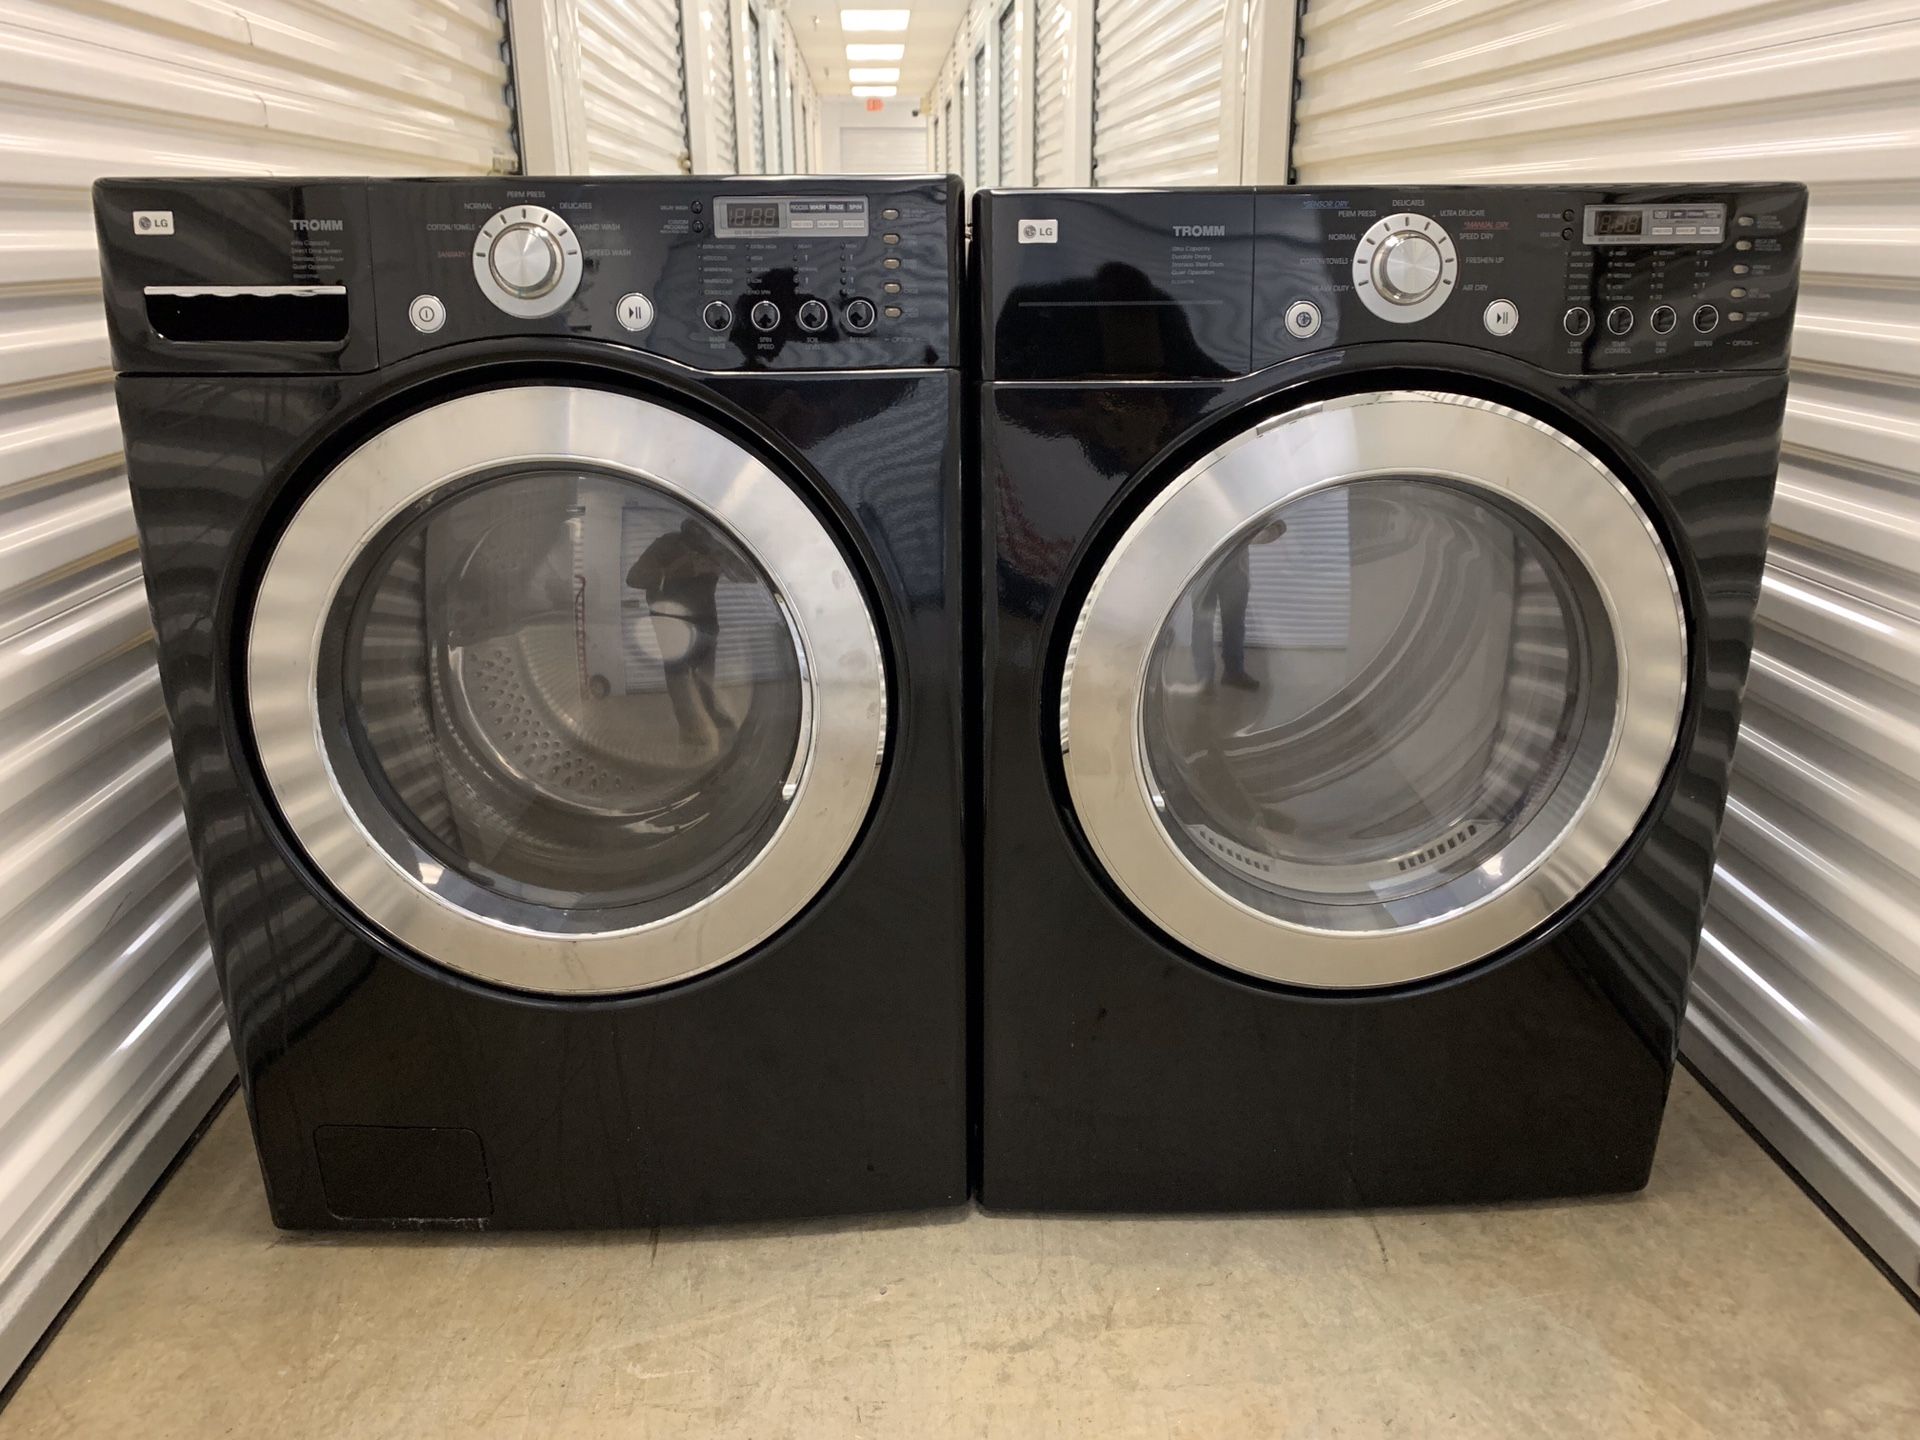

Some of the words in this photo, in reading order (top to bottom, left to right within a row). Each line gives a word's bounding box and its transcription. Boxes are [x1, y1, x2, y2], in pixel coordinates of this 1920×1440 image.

[507, 191, 526, 199] PERM
[559, 202, 593, 210] DELICATES
[809, 203, 827, 211] WASH
[829, 203, 845, 211] RINSE
[1392, 199, 1425, 207] DELICATES
[1338, 210, 1357, 218] PERM
[1439, 209, 1457, 217] ULTRA
[1457, 209, 1486, 217] DELICATE
[154, 219, 169, 228] LG
[290, 219, 344, 232] TROMM
[1039, 227, 1053, 236] LG
[1172, 225, 1226, 237] TROMM
[1328, 233, 1357, 241] NORMAL
[1480, 232, 1495, 240] DRY
[589, 249, 611, 257] SPEED
[611, 249, 632, 257] WASH
[1465, 256, 1495, 264] FRESHEN
[1495, 256, 1505, 264] UP
[1461, 283, 1475, 292] AIR
